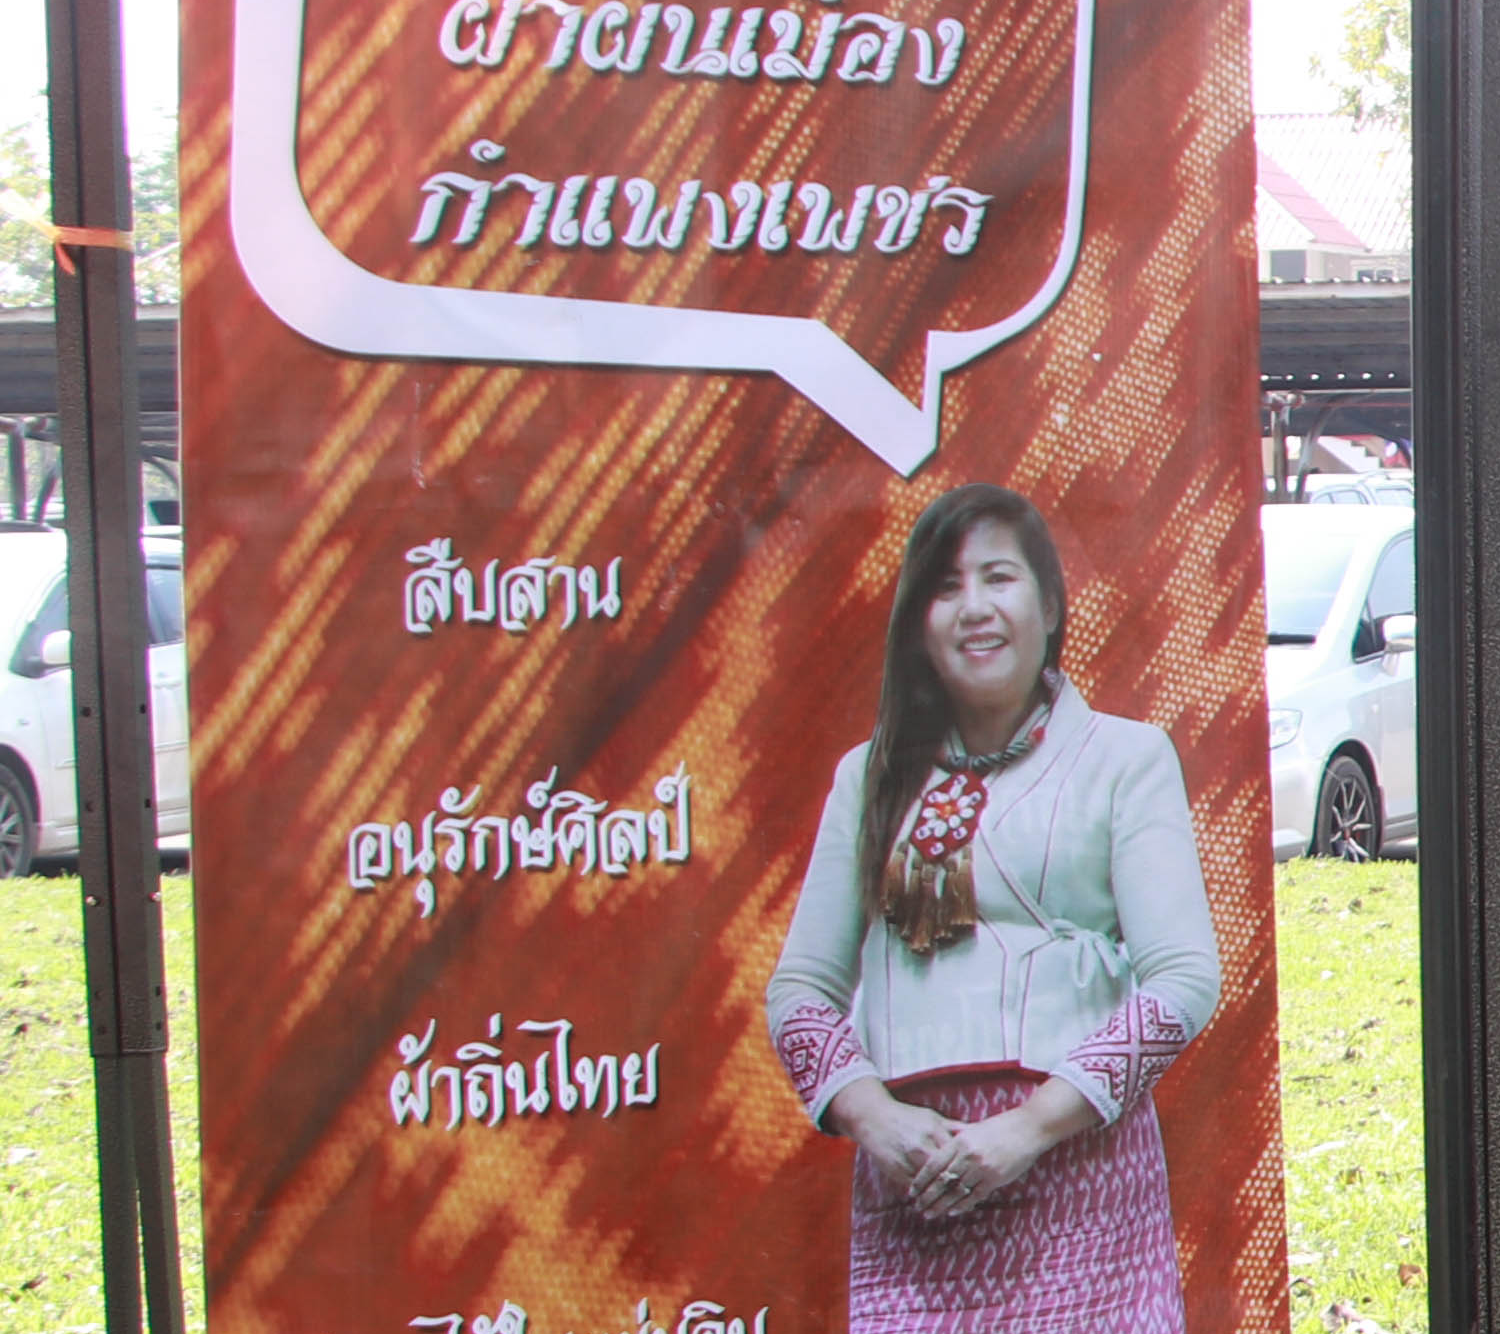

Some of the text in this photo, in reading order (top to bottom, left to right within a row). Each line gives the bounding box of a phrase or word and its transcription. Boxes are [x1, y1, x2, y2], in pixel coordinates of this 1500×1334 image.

[409, 138, 995, 255] กำแพงเพชร
[405, 537, 622, 634] สืบสาน
[349, 759, 691, 919] อนุรักษ์ศิลป์
[388, 1012, 661, 1132] ผ้าถิ่นไทย
